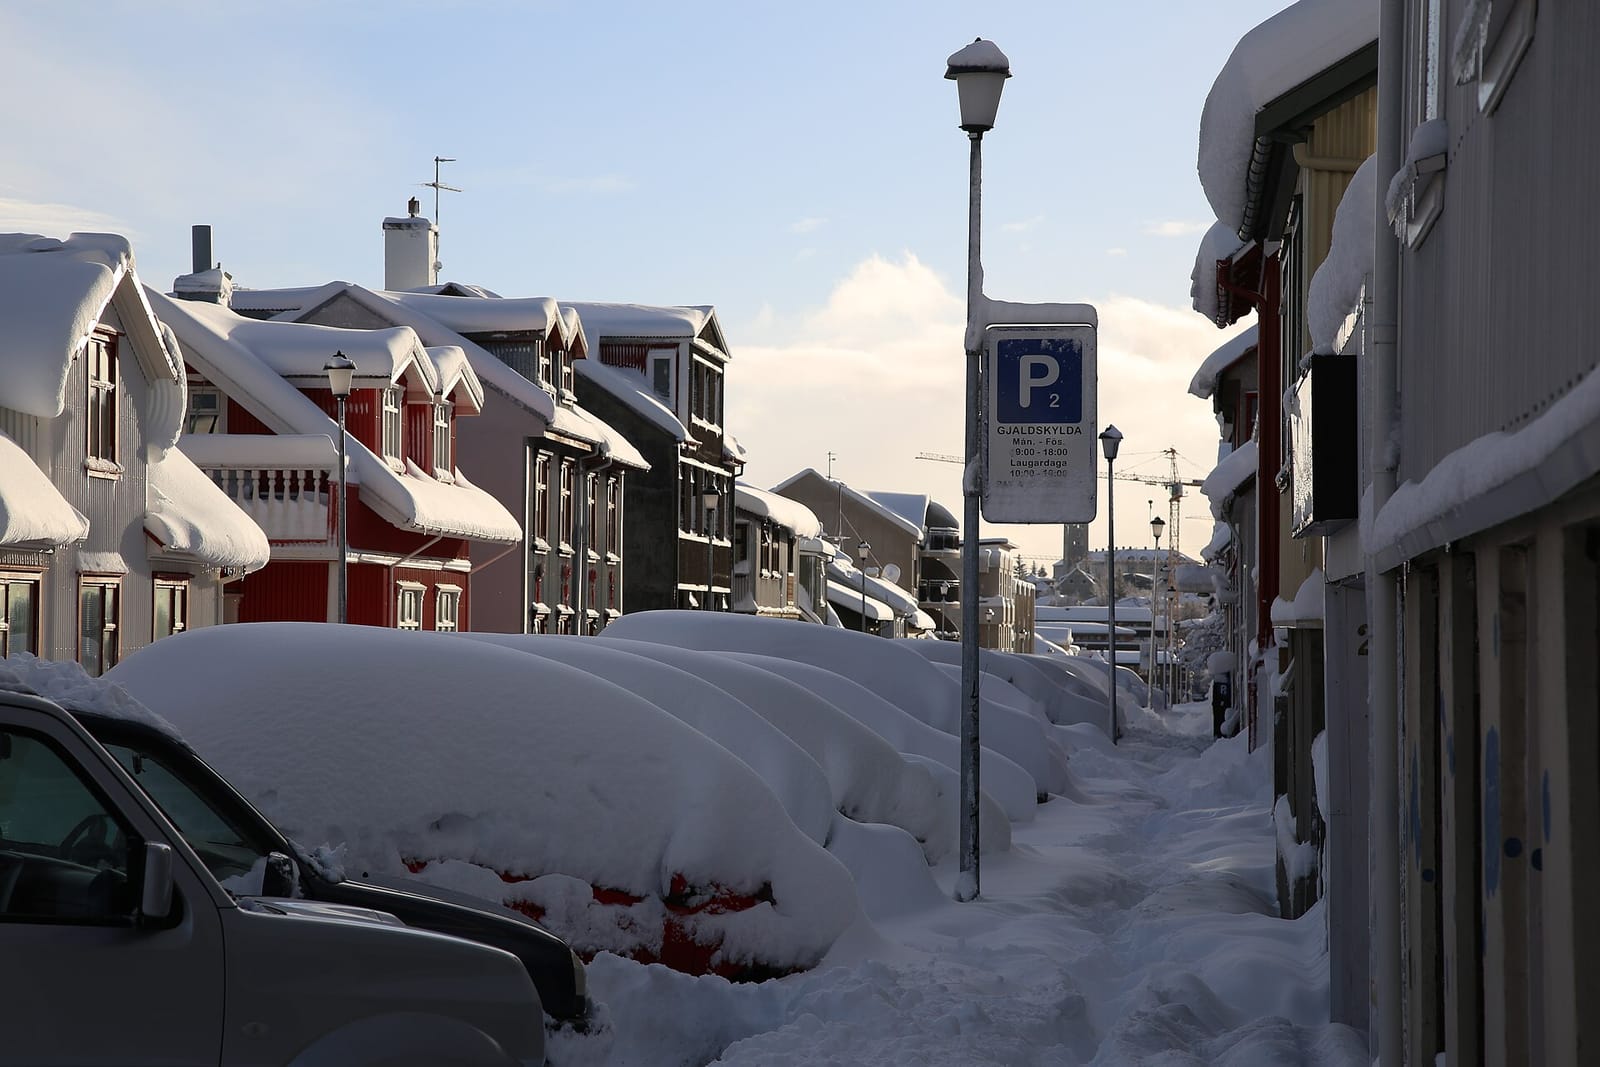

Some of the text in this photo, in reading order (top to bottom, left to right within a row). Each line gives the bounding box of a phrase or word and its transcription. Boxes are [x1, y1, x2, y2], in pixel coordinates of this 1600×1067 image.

[1019, 354, 1060, 408] P 2
[997, 426, 1082, 435] GJALDSKYLDA
[1043, 448, 1068, 456] 18:00
[1010, 459, 1067, 468] Laugardaga
